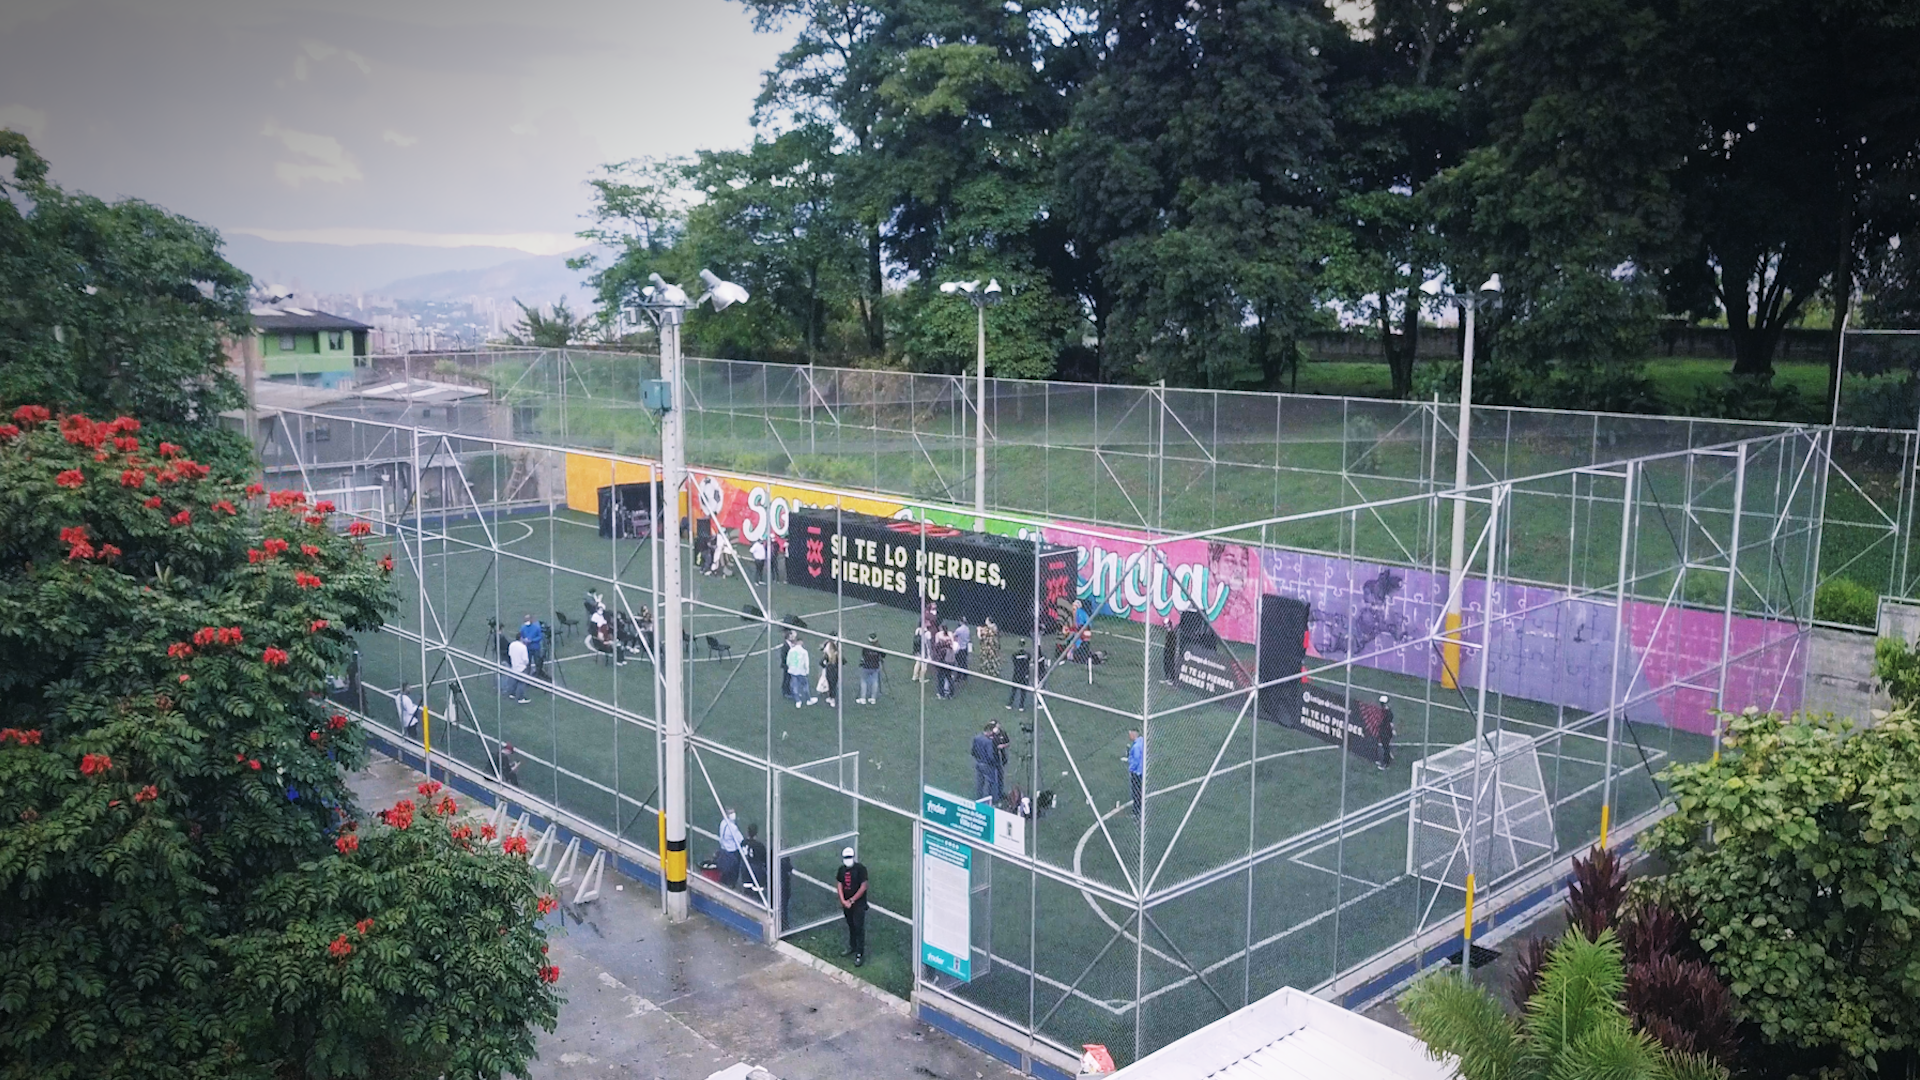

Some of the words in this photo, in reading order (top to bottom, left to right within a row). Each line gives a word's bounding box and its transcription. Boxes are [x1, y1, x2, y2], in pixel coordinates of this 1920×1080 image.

[831, 534, 848, 555] SI
[855, 538, 877, 563] TE
[885, 543, 908, 568] LO
[916, 550, 1006, 590] PIERDES,
[831, 559, 907, 594] PIERDES
[917, 574, 945, 601] TÚ.
[1179, 673, 1205, 688] PIERDES
[1181, 664, 1188, 673] SI
[1189, 667, 1197, 677] TE
[1198, 670, 1206, 679] LO
[1301, 716, 1330, 734] PIERDES
[1302, 706, 1309, 715] SI
[1311, 709, 1320, 718] TE
[1321, 713, 1330, 723] LO
[1332, 717, 1365, 738] PIEDES,
